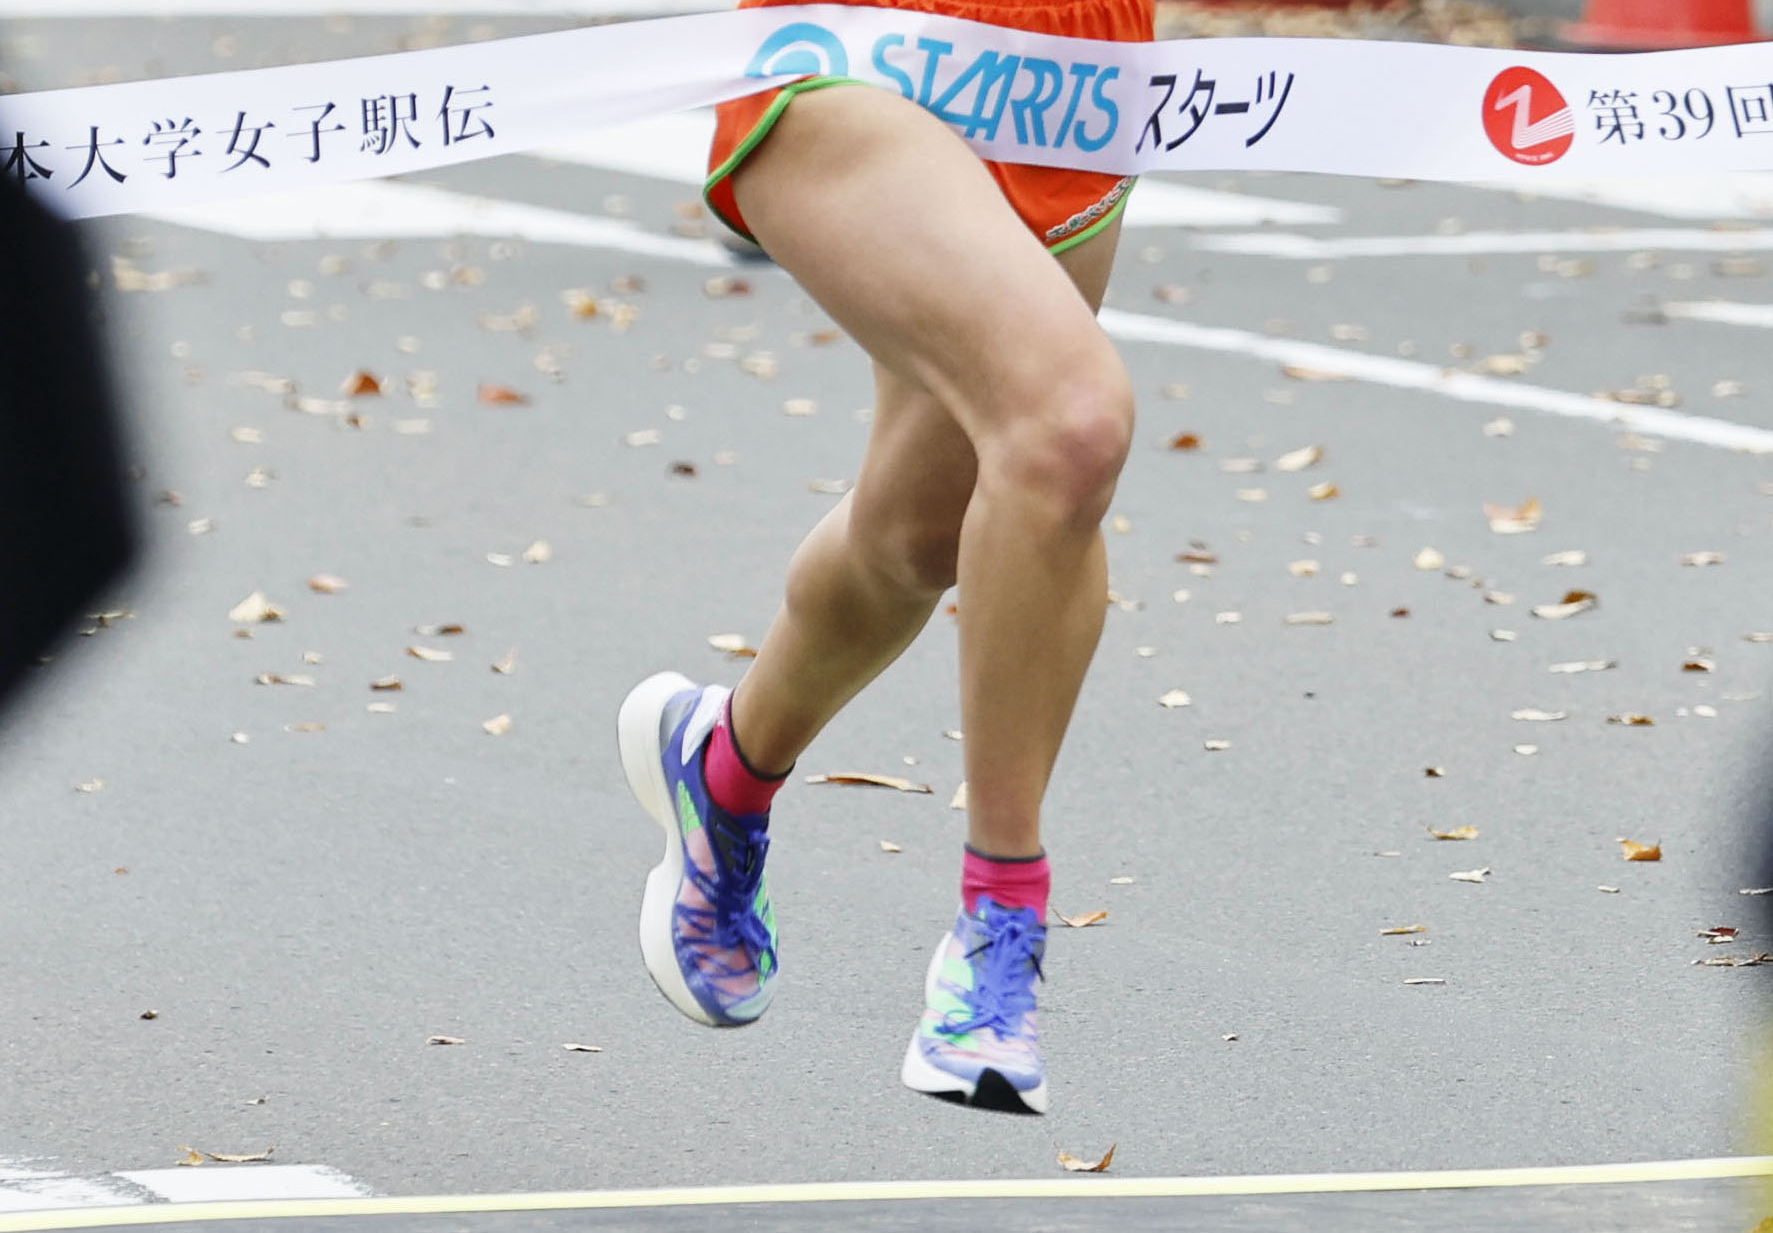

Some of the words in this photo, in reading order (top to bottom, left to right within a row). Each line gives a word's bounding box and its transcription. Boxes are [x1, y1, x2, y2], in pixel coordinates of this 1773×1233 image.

[0, 85, 495, 190] 本大学女子駅伝
[1135, 68, 1295, 156] スターツ
[1587, 83, 1773, 144] 第39回
